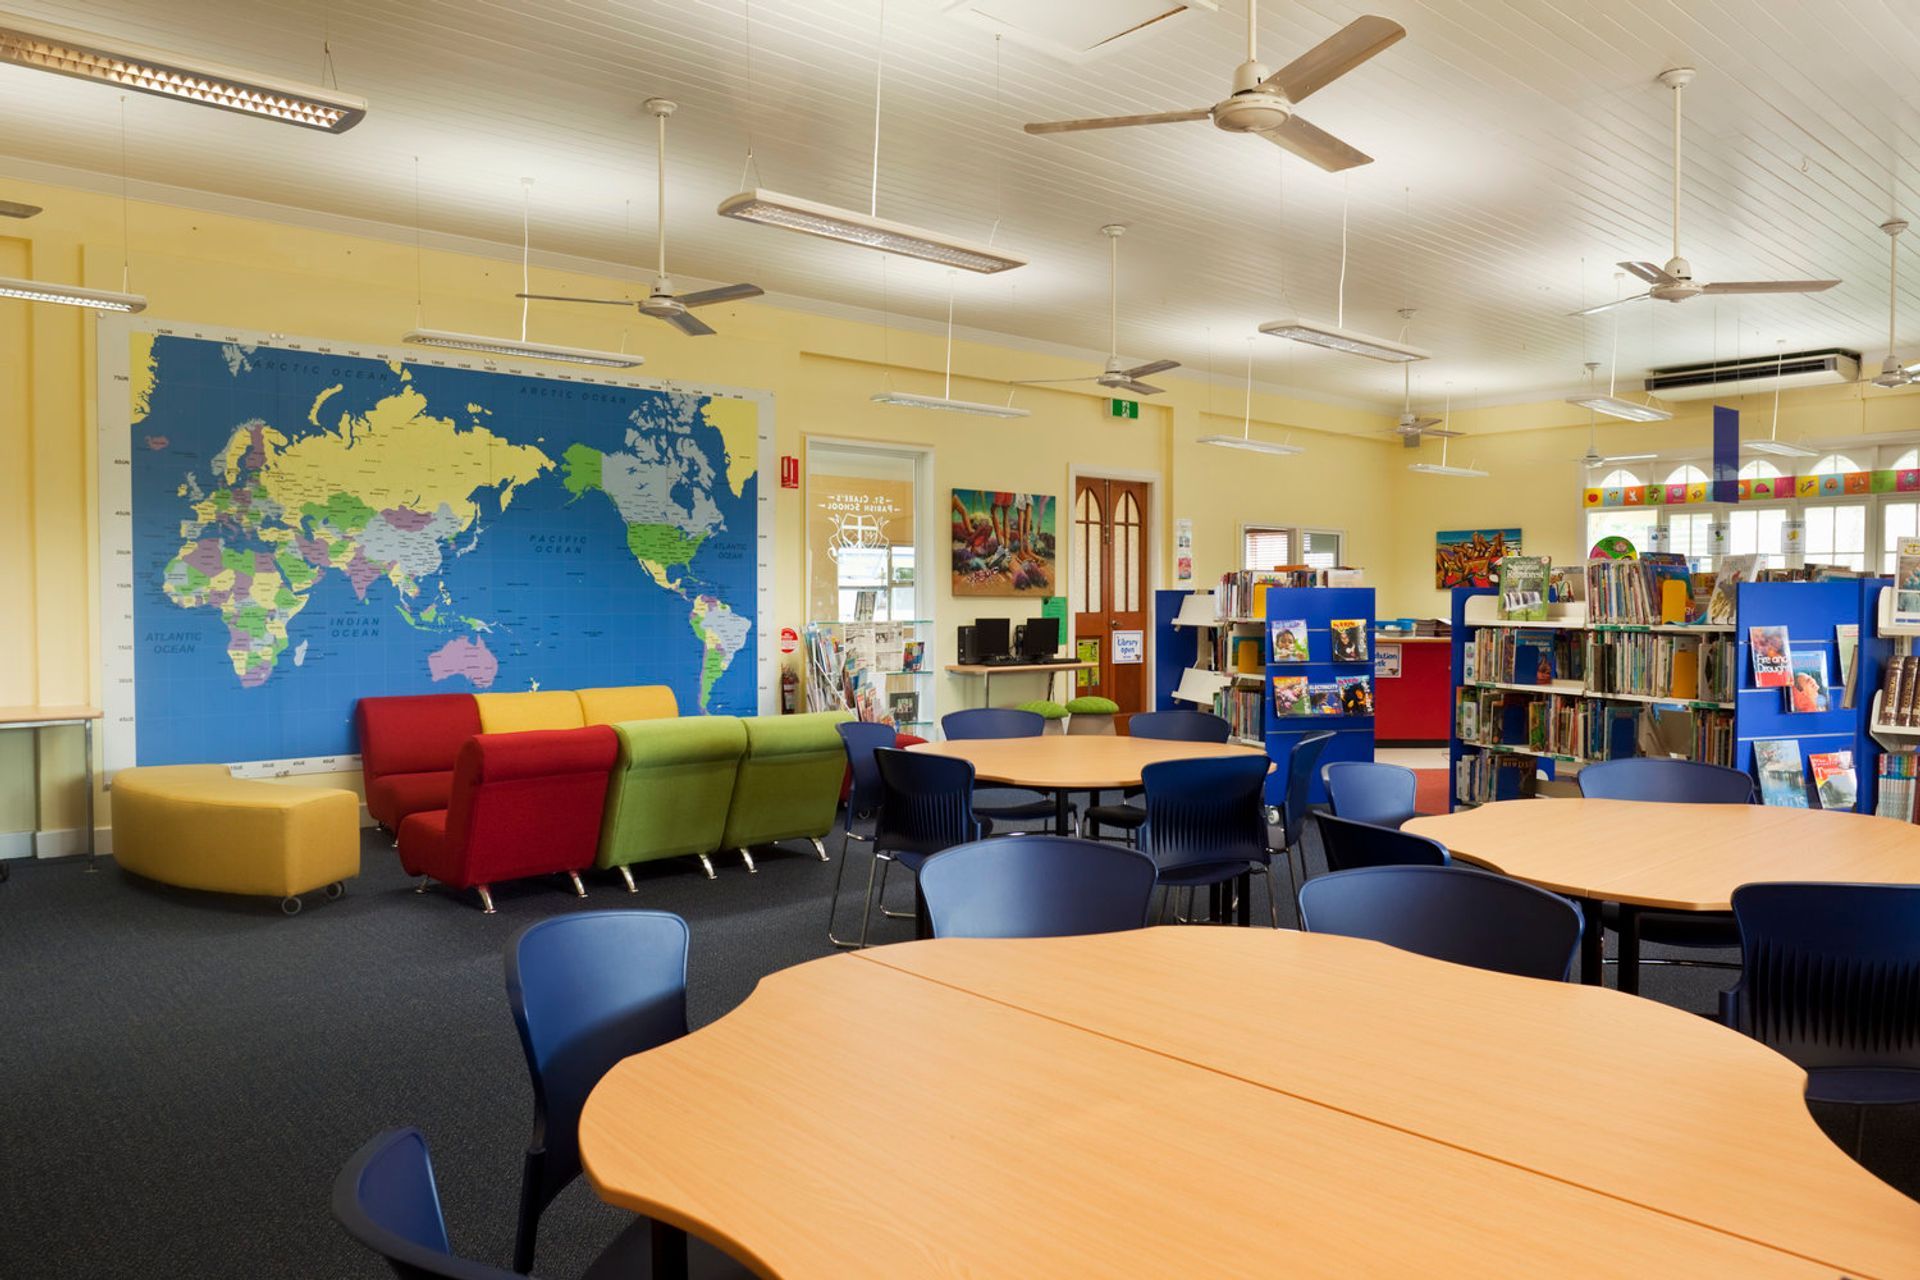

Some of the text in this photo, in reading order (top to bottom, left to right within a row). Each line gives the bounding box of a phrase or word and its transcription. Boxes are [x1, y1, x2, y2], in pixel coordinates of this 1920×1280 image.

[253, 360, 388, 381] ARCTIC OCEAN
[520, 386, 626, 404] ARCTIC OCEAN
[529, 534, 587, 544] PACIFIC
[535, 545, 582, 554] OCEAN
[330, 617, 380, 626] INDIAN
[145, 632, 203, 642] ATLANTIC
[331, 628, 380, 638] OCEAN
[1117, 638, 1138, 647] Library
[154, 644, 196, 654] OCEAN
[1120, 647, 1136, 655] open
